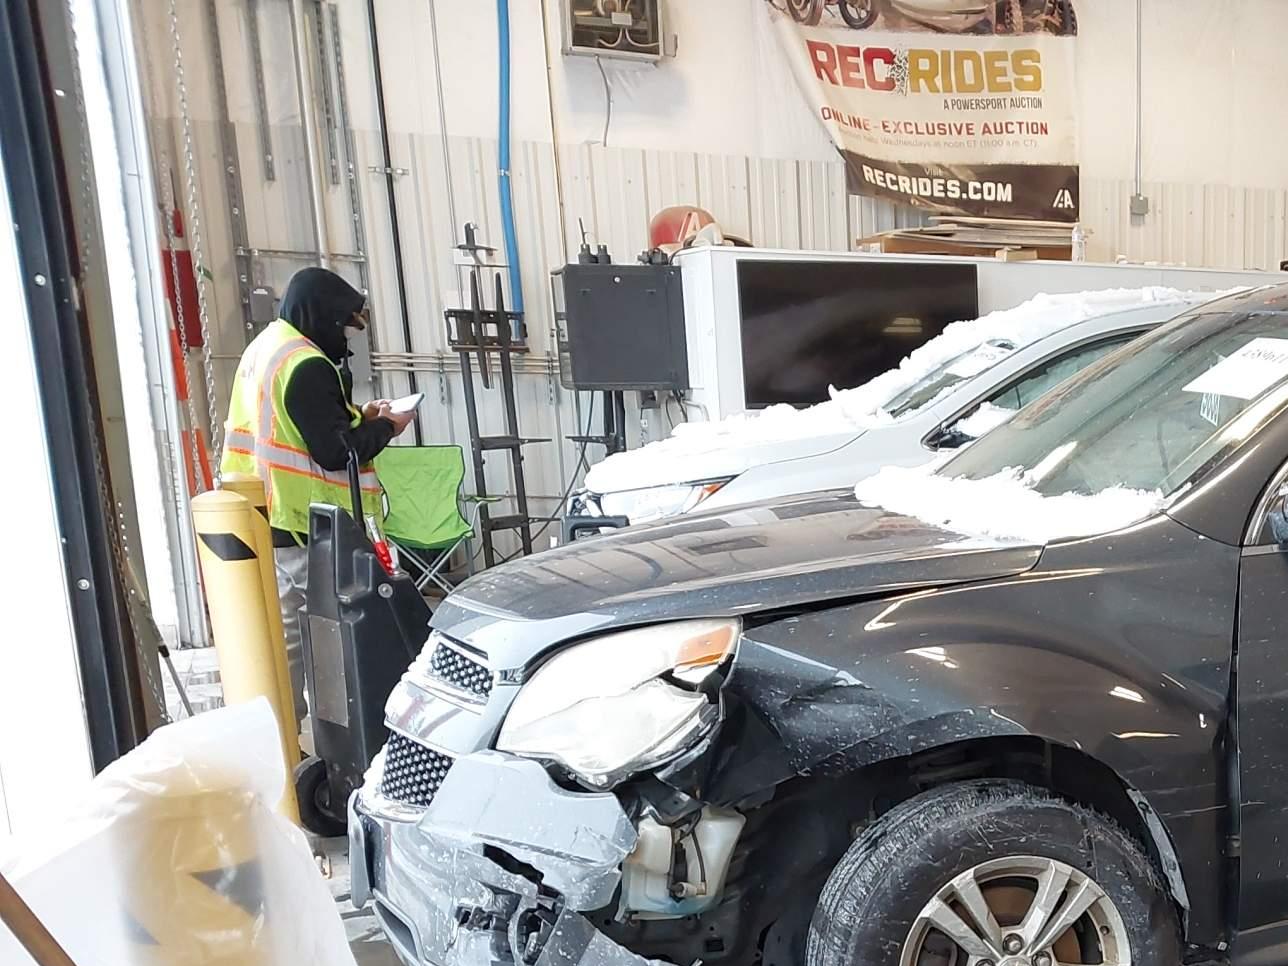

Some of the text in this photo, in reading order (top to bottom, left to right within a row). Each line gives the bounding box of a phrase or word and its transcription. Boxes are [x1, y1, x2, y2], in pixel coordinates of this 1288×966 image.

[806, 40, 1043, 93] REC RIDES
[943, 96, 1043, 111] A POWERSPORT AUCTION
[981, 121, 1049, 136] AUCTION
[862, 164, 1013, 203] RECRIDES.COM
